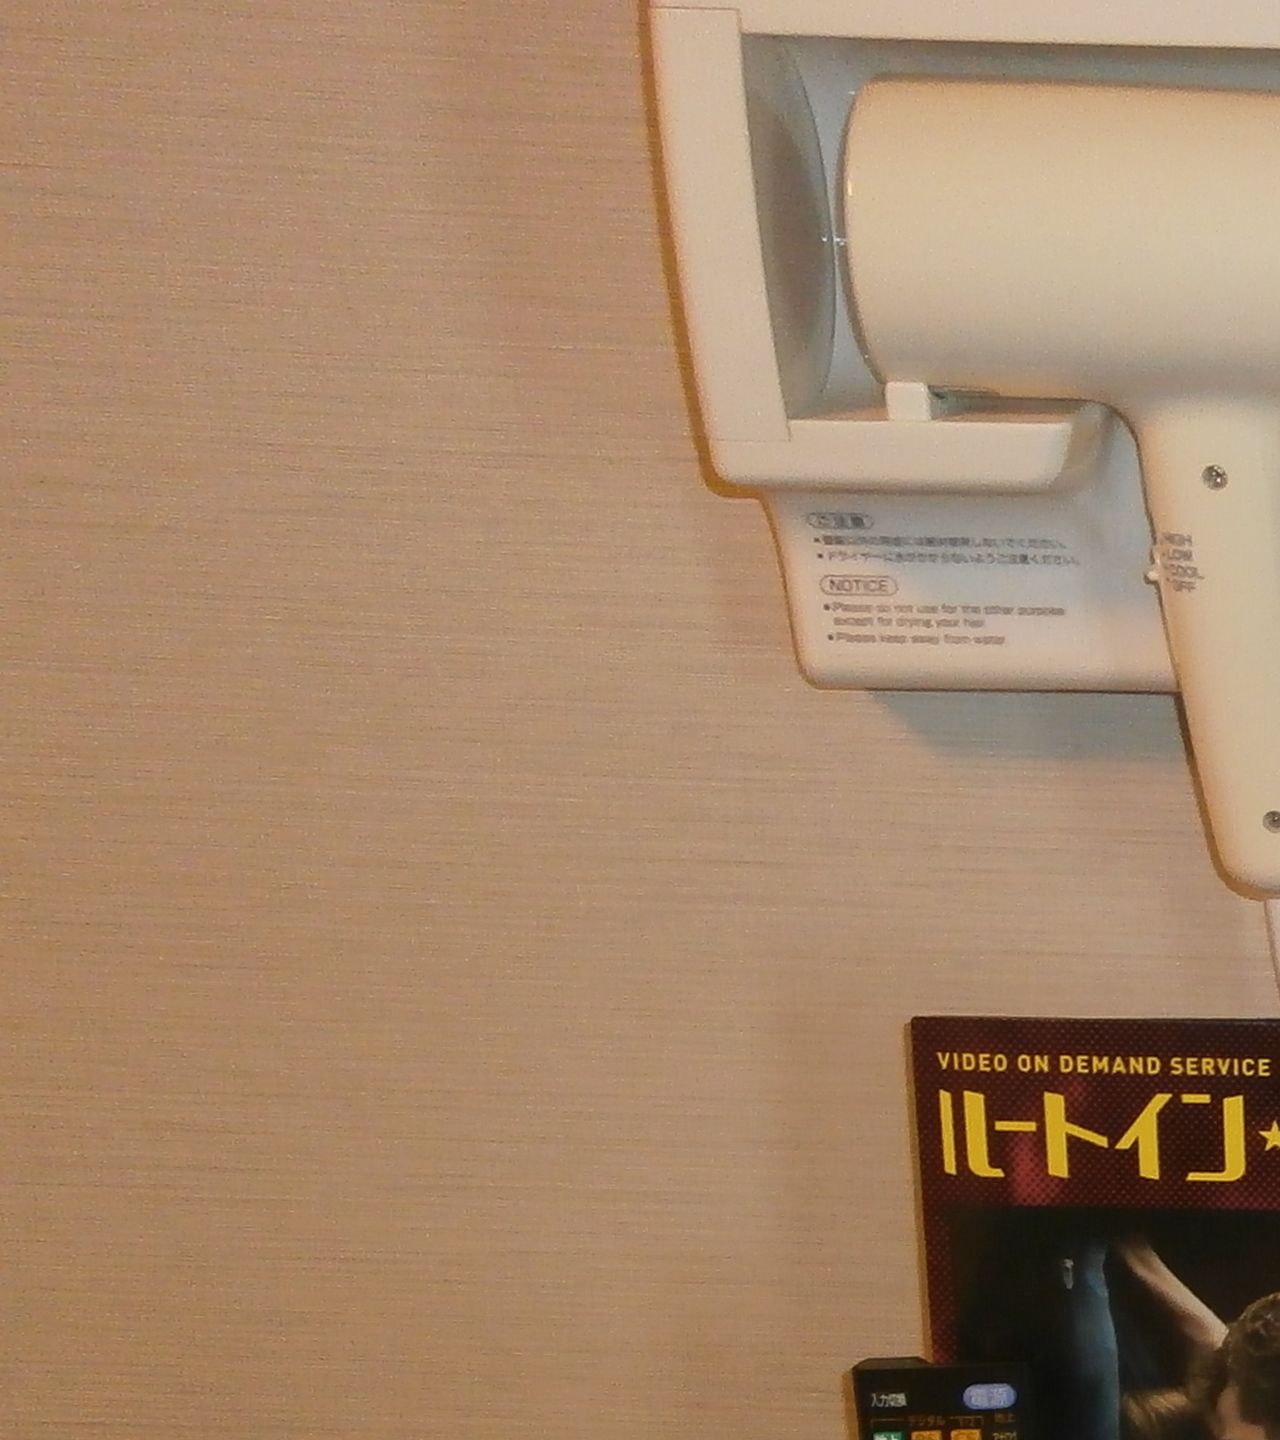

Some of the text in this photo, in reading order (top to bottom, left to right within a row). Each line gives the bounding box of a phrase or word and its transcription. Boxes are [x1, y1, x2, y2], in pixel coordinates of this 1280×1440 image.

[829, 578, 888, 594] NOTICE
[941, 602, 957, 613] for
[877, 617, 892, 626] for
[937, 1052, 1007, 1071] VIDEO
[1017, 1054, 1049, 1073] ON
[1060, 1055, 1161, 1075] DEMAND
[1170, 1058, 1271, 1077] SERVICE
